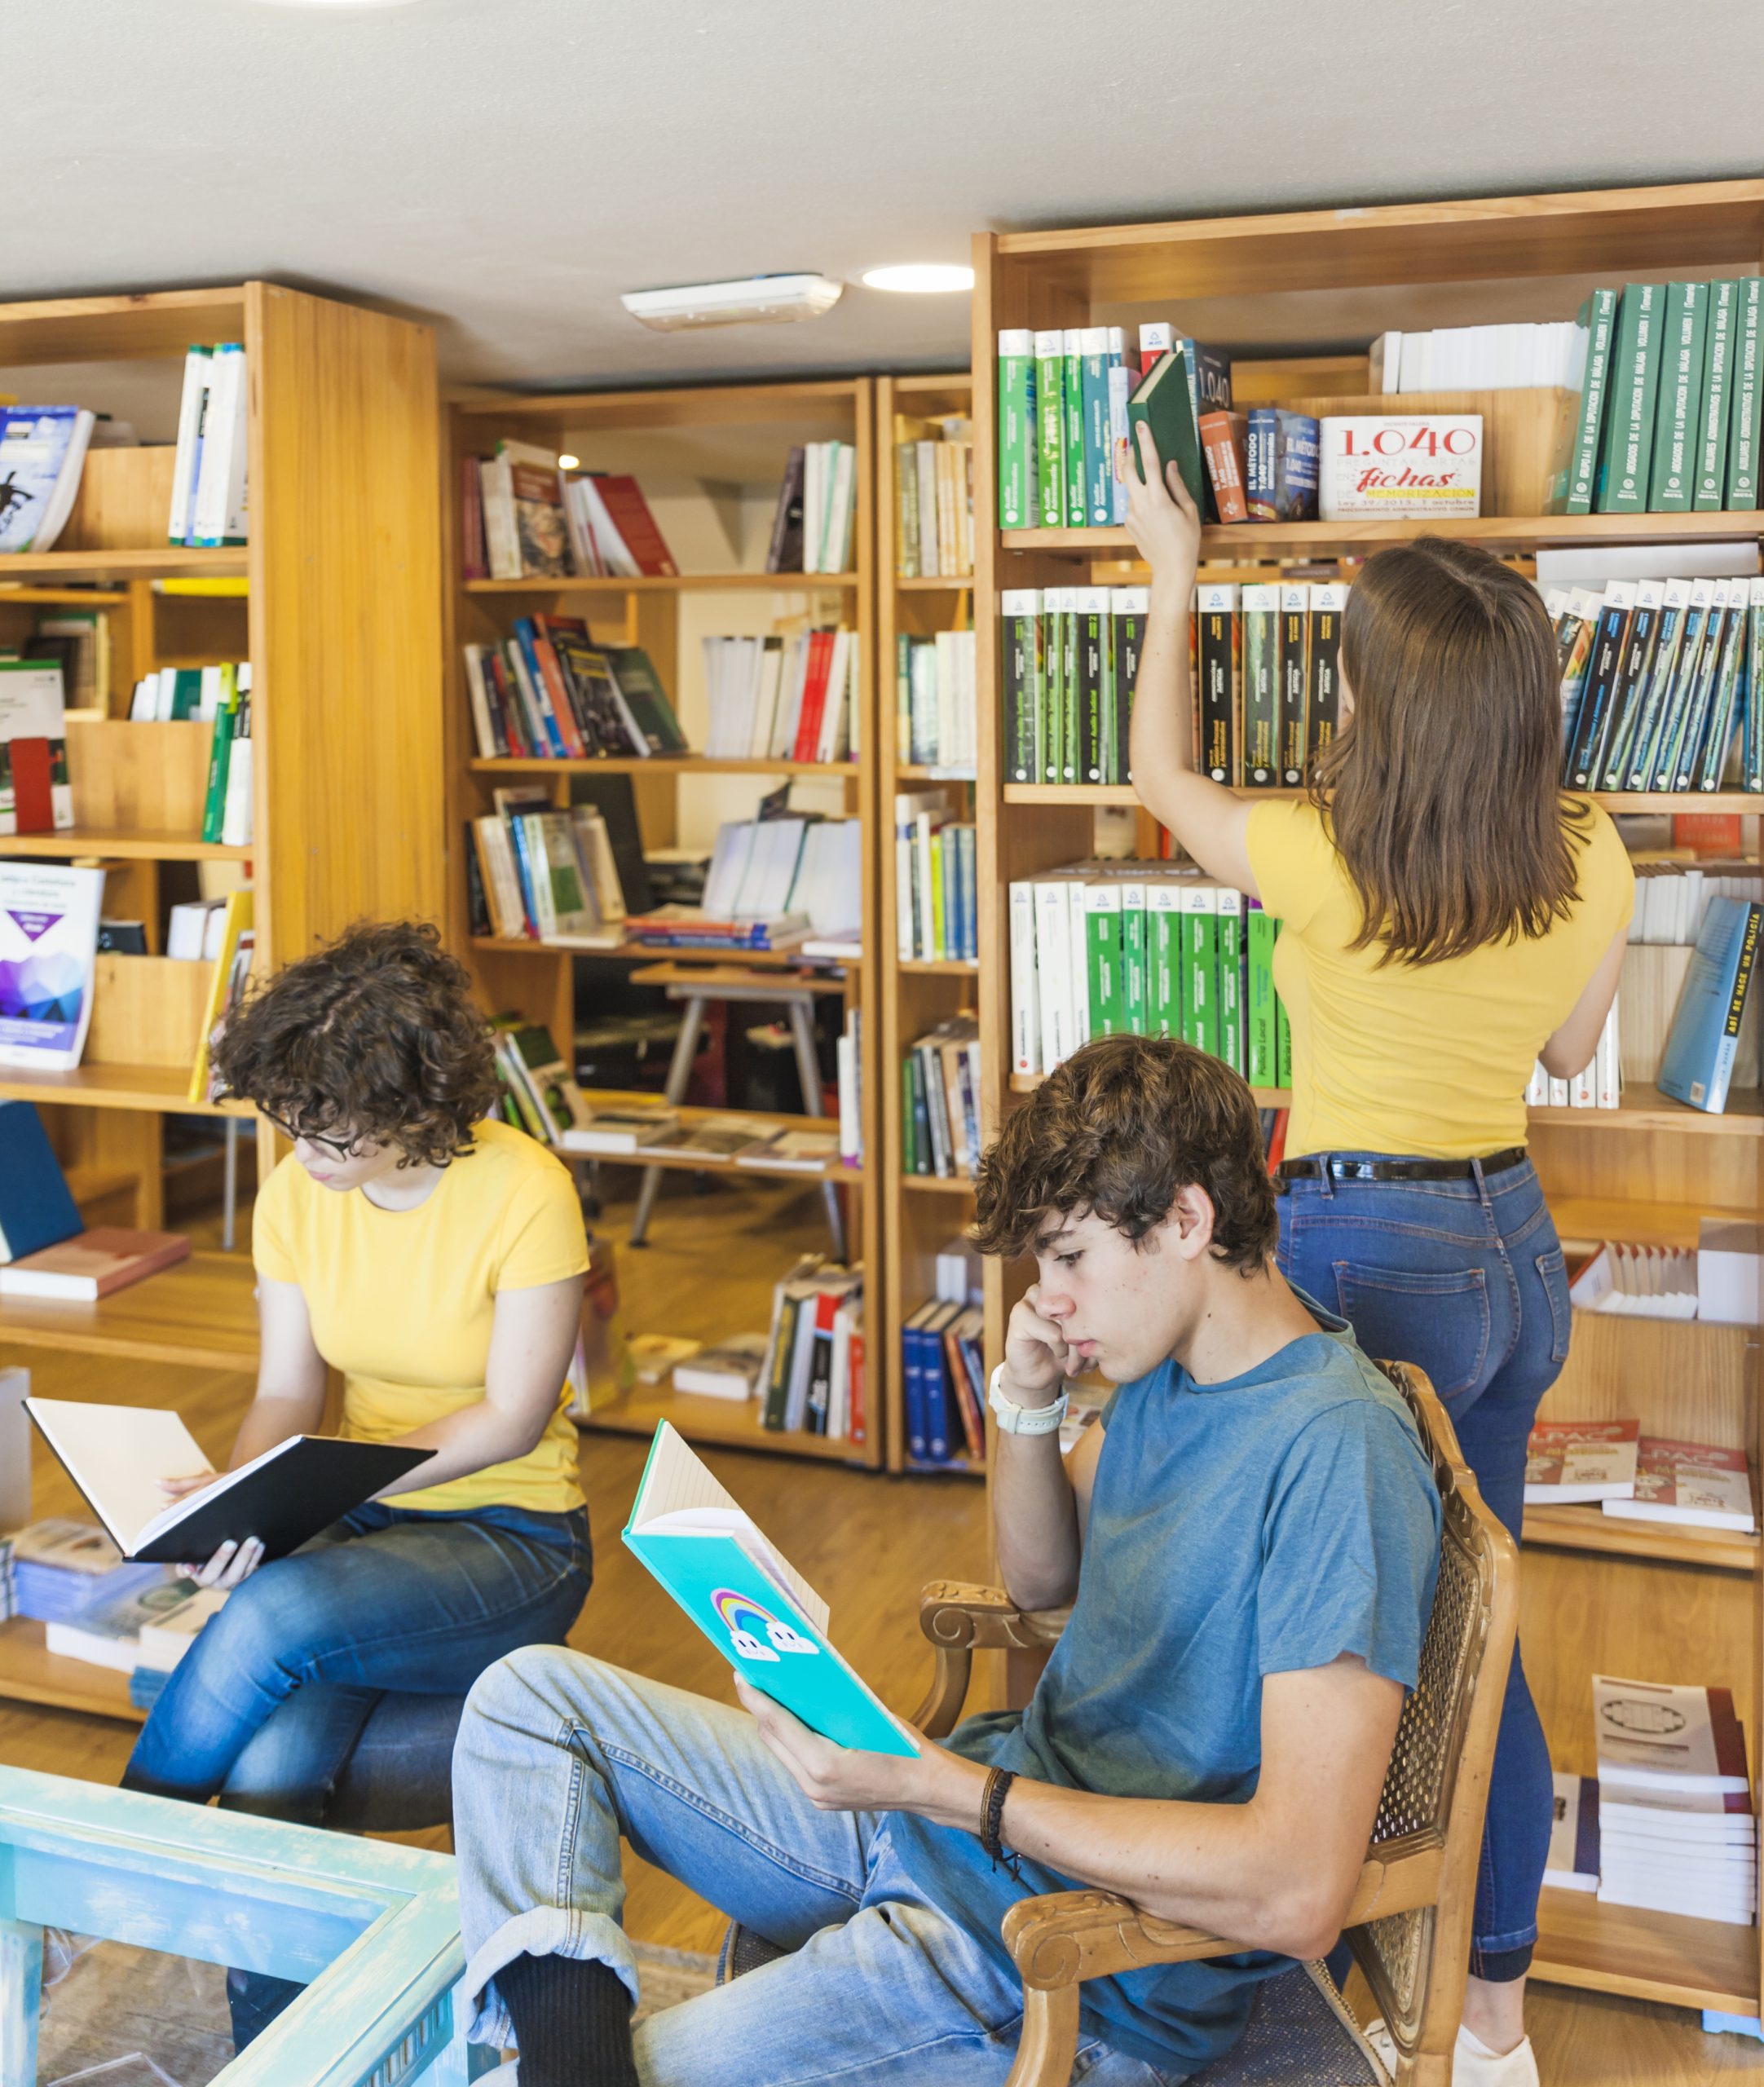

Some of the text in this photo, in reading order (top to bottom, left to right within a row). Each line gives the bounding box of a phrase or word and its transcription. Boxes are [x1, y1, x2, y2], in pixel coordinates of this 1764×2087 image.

[1715, 308, 1727, 330] MÁLAGA
[1746, 306, 1758, 328] MÁLAGA
[1638, 320, 1651, 346] VOLUMEN
[1682, 318, 1693, 345] VOLUMEN
[1716, 332, 1726, 340] DE
[1747, 329, 1757, 338] DE
[1634, 351, 1646, 375] MÁLAGA
[1678, 350, 1690, 373] MÁLAGA
[1634, 377, 1644, 385] DE
[1678, 375, 1688, 383] DE
[1712, 375, 1722, 383] LA
[1744, 373, 1753, 381] LA
[1199, 367, 1230, 408] 1.040
[1712, 384, 1722, 392] DE
[1744, 382, 1753, 390] DE
[1630, 422, 1639, 430] LA
[1675, 421, 1685, 429] LA
[1582, 436, 1593, 444] DE
[1629, 432, 1639, 441] DE
[1674, 431, 1684, 439] DE
[1286, 437, 1294, 452] EL
[1338, 428, 1475, 457] 1.040
[1247, 433, 1257, 490] EL MÉTODO
[1337, 457, 1475, 467] PREGUNTAS CORTAS
[1626, 443, 1638, 474] ABOGADOS
[1672, 442, 1683, 473] ABOGADOS
[1259, 464, 1267, 490] 1.040
[1356, 467, 1456, 492] fichas
[1337, 490, 1355, 499] DE
[1366, 488, 1475, 498] MEMORIZACIÓN
[1745, 913, 1759, 951] POLICÍA
[1742, 955, 1752, 968] UN
[1735, 973, 1747, 995] HACE
[1258, 1018, 1266, 1076] Policía Local
